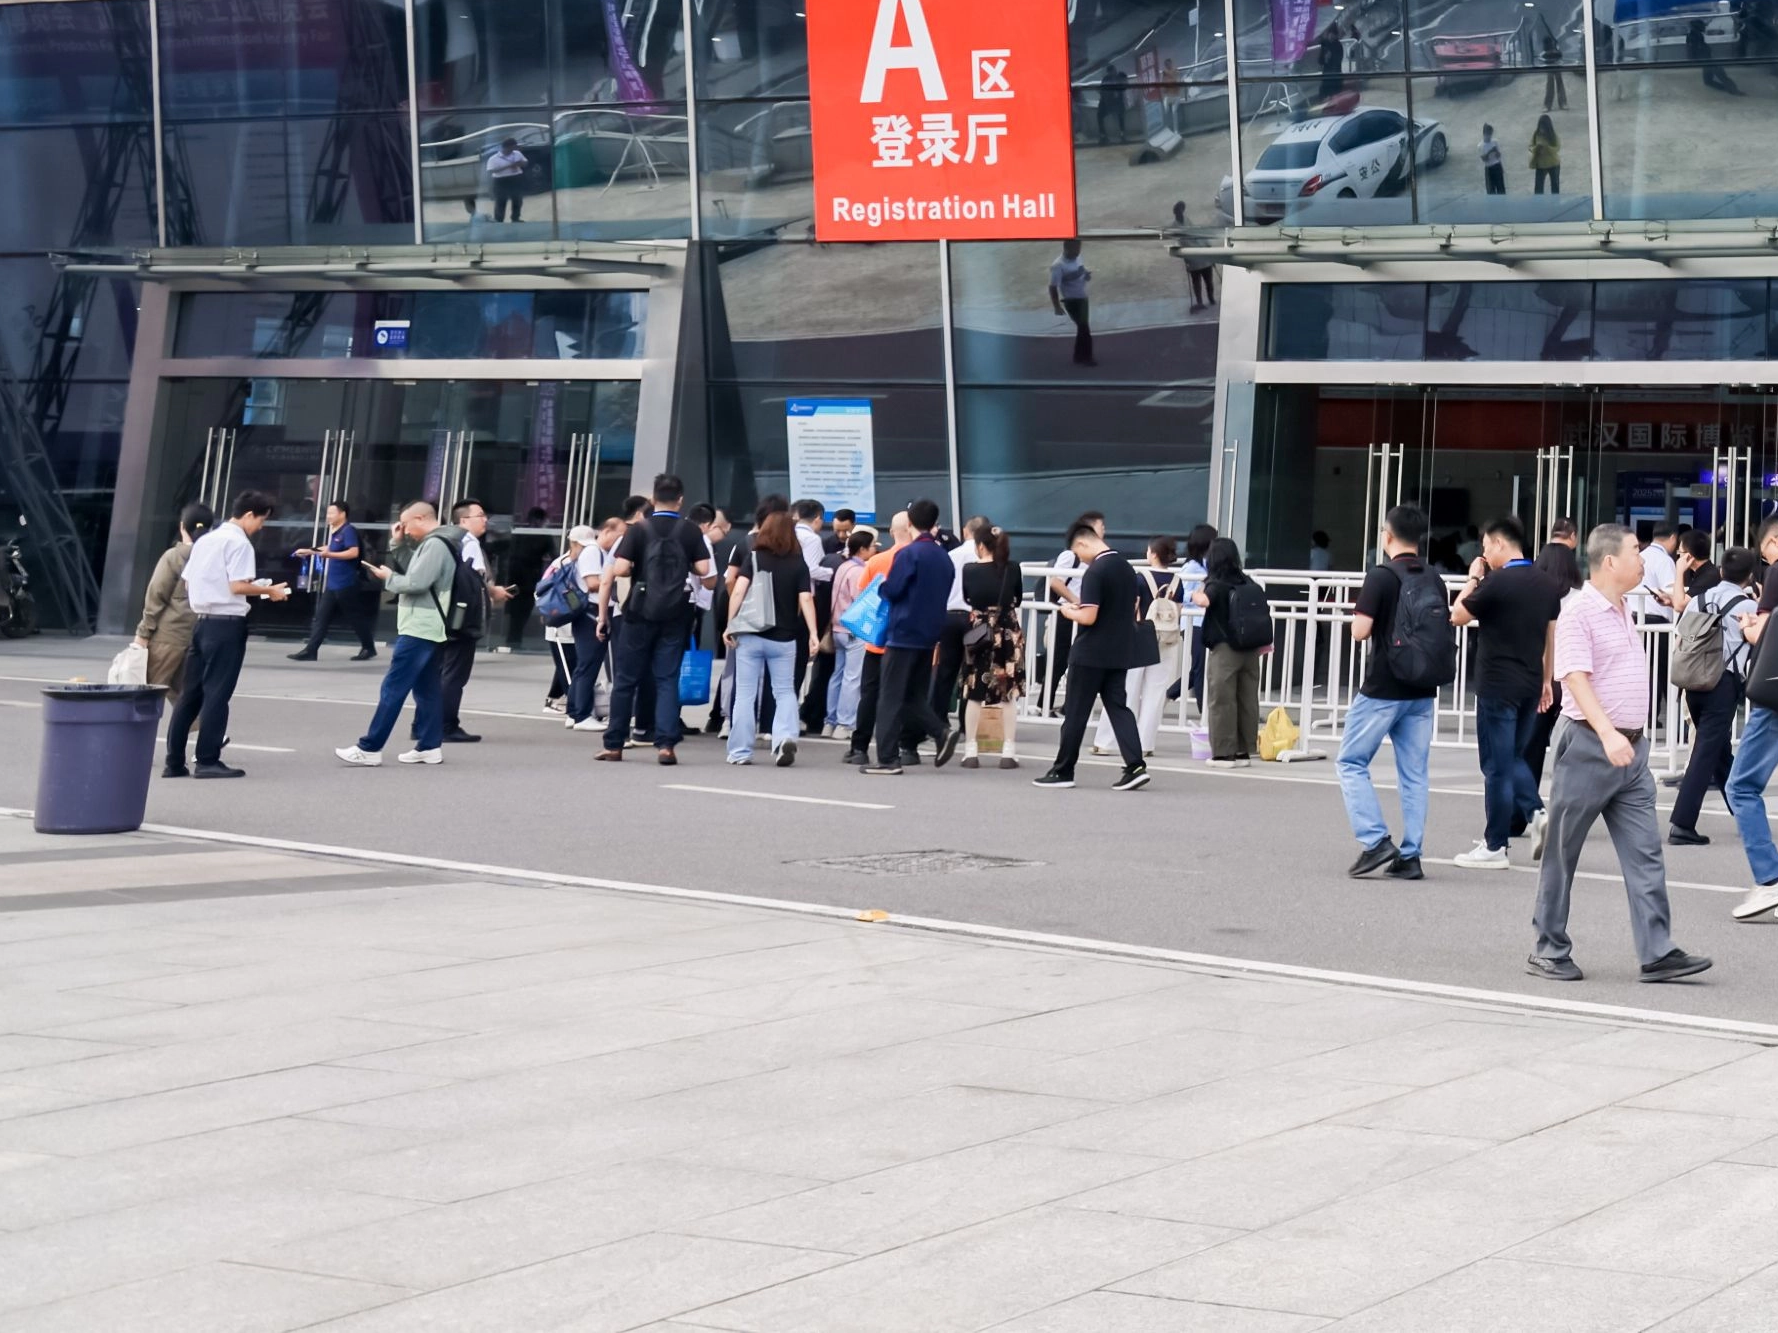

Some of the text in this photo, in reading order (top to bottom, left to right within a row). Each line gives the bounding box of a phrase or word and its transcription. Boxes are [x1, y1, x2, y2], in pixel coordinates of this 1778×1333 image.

[971, 48, 1014, 99] 区
[870, 113, 1008, 168] 登录厅
[832, 193, 1055, 227] Registration Hall
